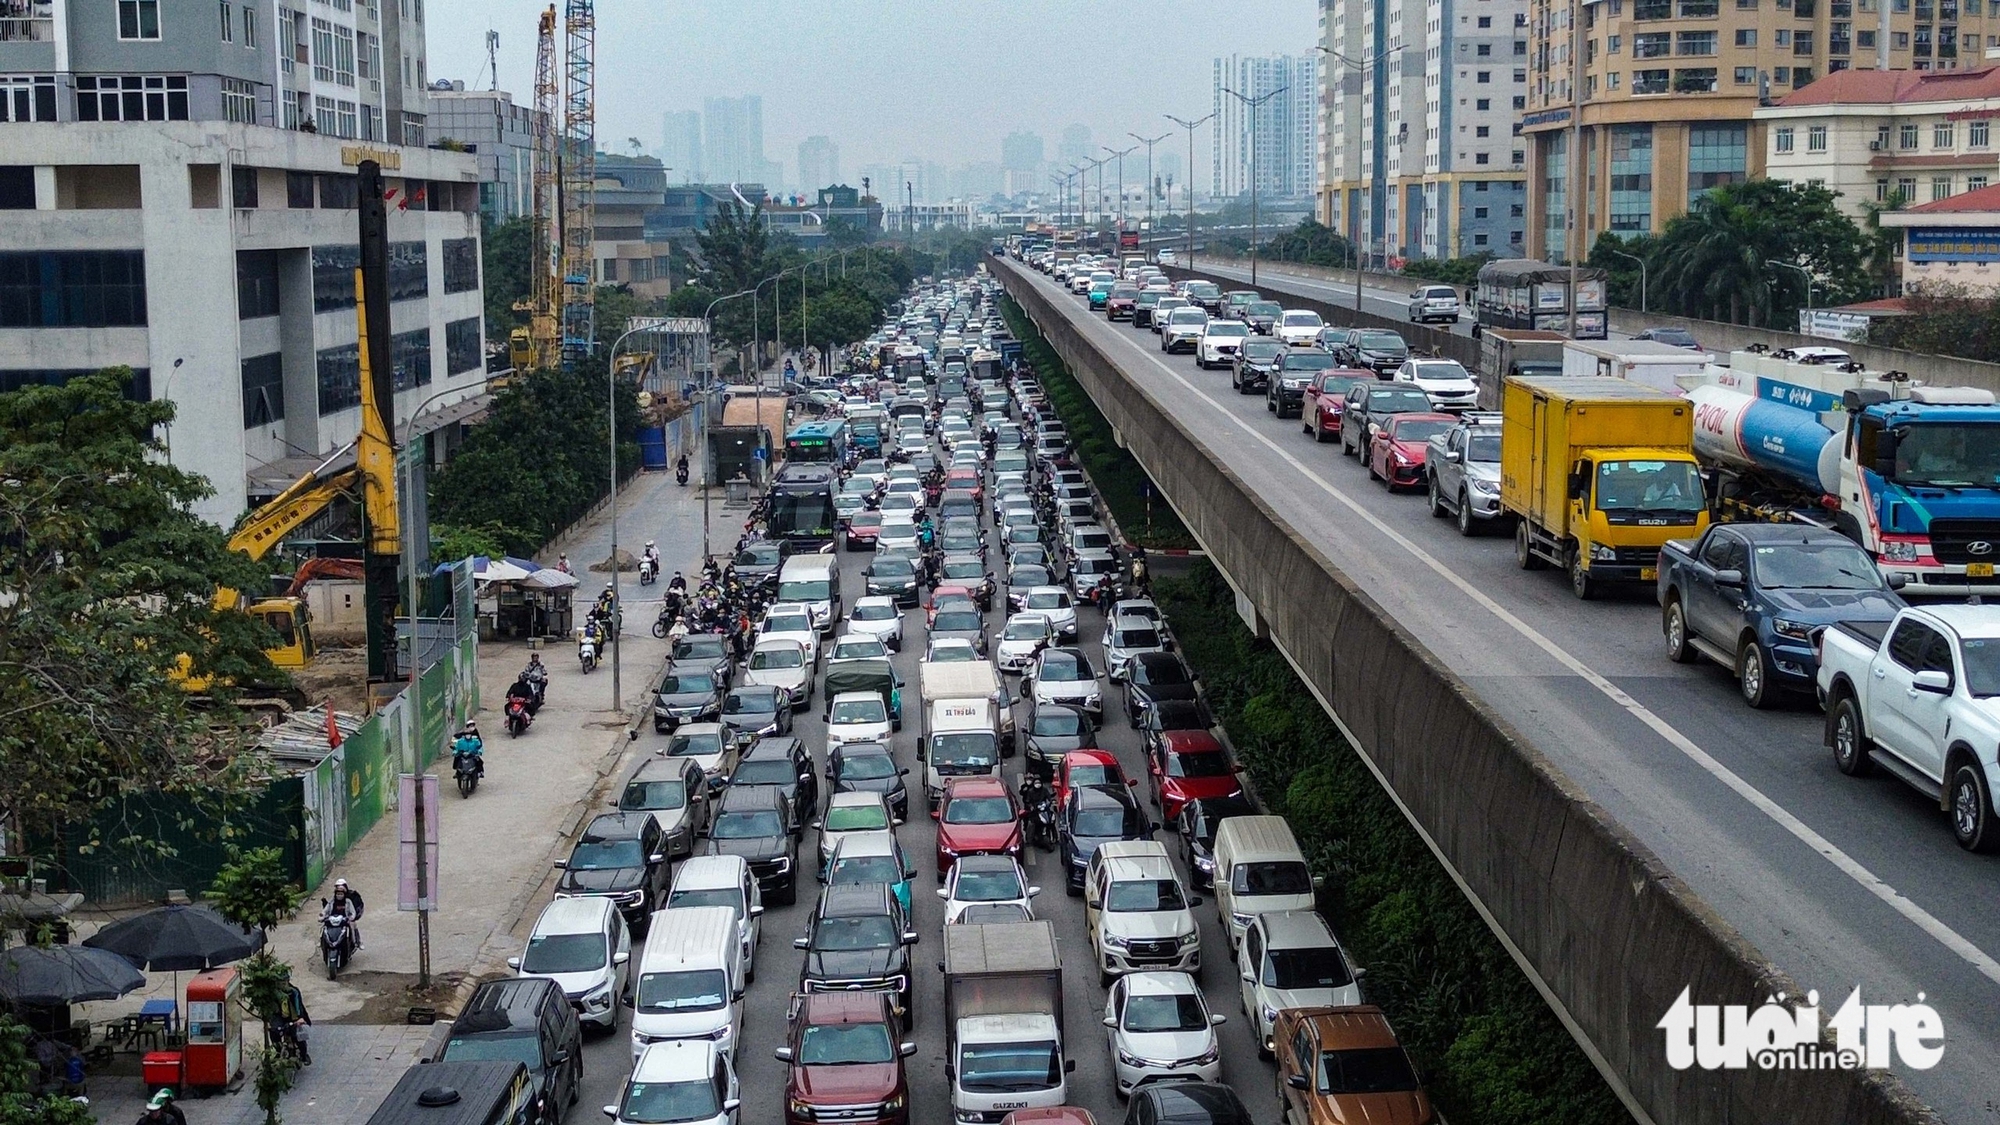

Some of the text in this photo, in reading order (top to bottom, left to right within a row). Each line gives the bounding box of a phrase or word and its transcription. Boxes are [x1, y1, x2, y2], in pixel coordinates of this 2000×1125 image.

[1694, 403, 1728, 435] PVOIL
[1638, 518, 1668, 526] ISUZU
[992, 1101, 1028, 1109] SUZUKI
